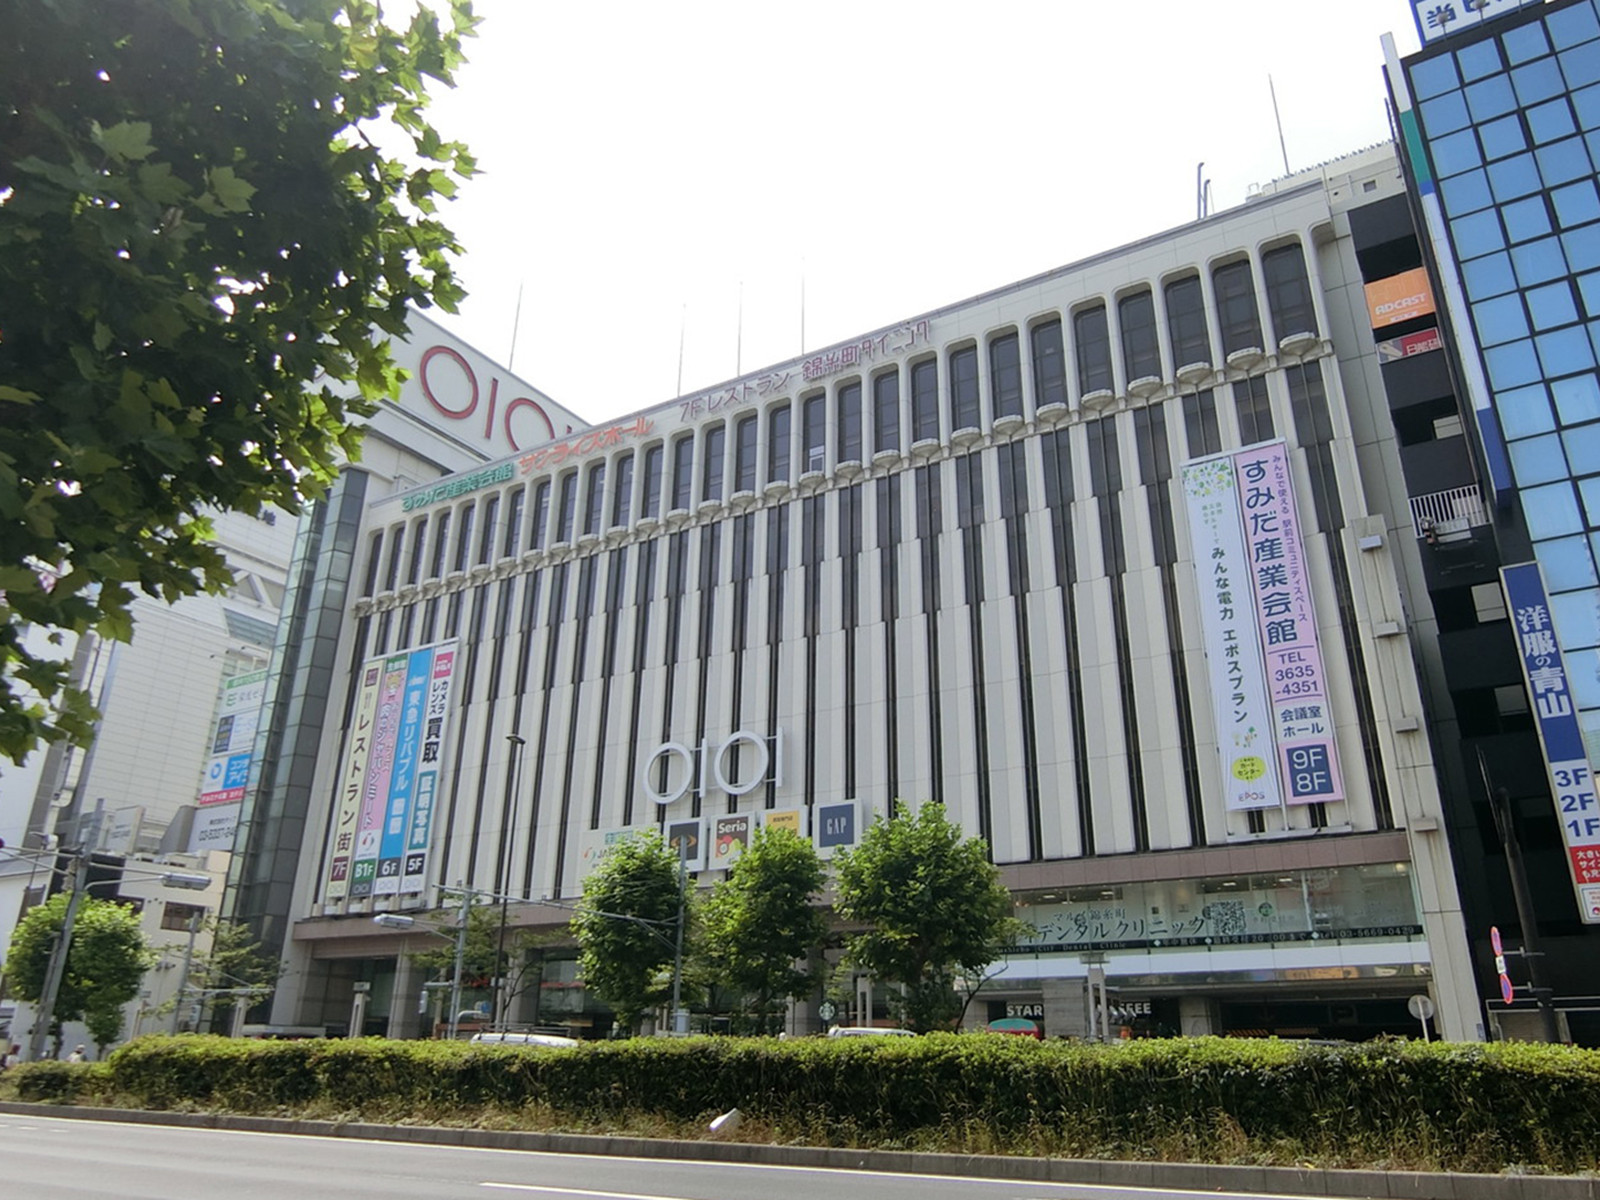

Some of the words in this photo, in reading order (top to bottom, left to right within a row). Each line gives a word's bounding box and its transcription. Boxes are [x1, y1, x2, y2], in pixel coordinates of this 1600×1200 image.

[1241, 459, 1298, 646] すみだ産業会館
[1211, 547, 1234, 621] みんな電力
[1223, 628, 1248, 723] エポスプラン
[1278, 652, 1306, 664] TEL
[1516, 604, 1571, 719] 洋服の青山
[1275, 665, 1315, 682] 3635
[1275, 681, 1319, 696] -4351
[428, 682, 440, 715] レンズ
[437, 681, 449, 715] カメラ
[1280, 706, 1323, 723] 会議室
[1283, 722, 1324, 738] ホール
[422, 717, 443, 763] 買取
[1292, 748, 1323, 769] 9F
[337, 714, 370, 852] レストラン街
[1296, 771, 1326, 792] 8F
[1554, 768, 1588, 787] 3F
[1239, 791, 1265, 802] EPOS
[1560, 793, 1594, 812] 2F
[718, 820, 747, 833] Seria
[827, 817, 847, 835] GAP
[1567, 818, 1600, 837] 1F
[333, 861, 348, 876] 7F
[355, 863, 374, 878] B1F
[382, 861, 397, 875] 6F
[408, 858, 423, 871] 5F
[1007, 1005, 1042, 1016] STAR
